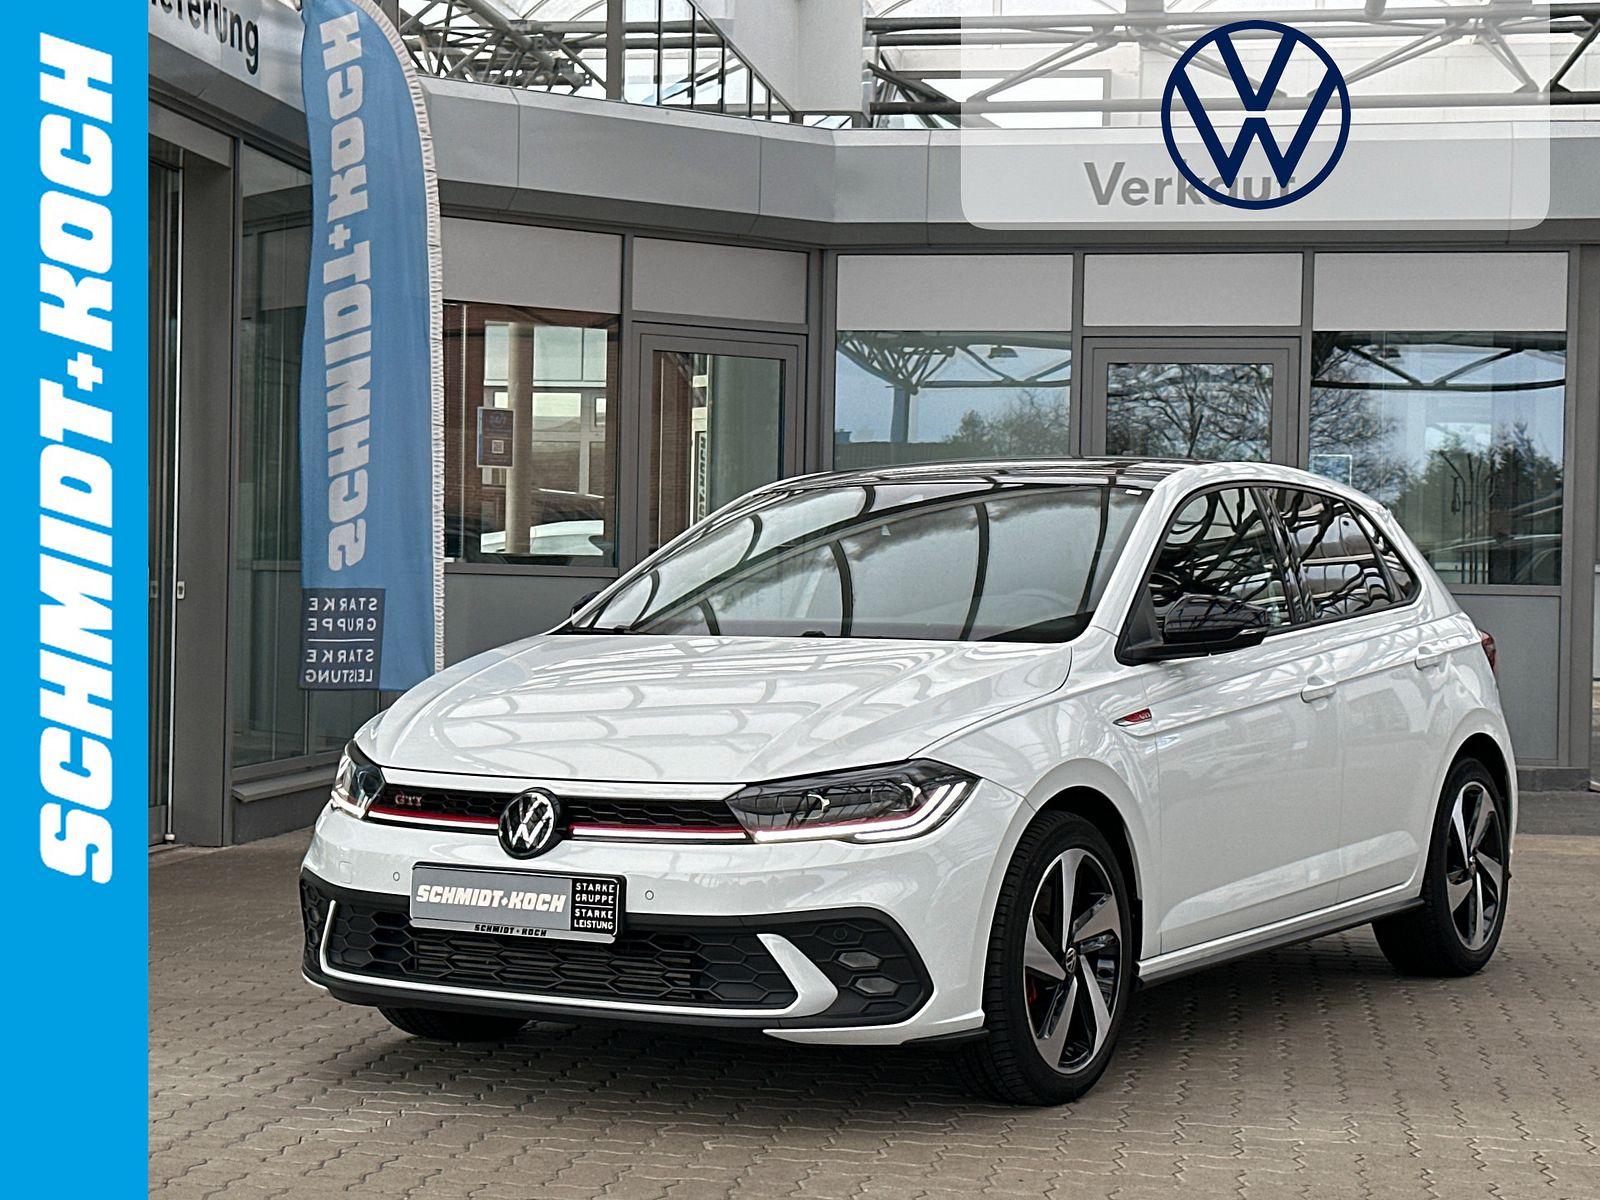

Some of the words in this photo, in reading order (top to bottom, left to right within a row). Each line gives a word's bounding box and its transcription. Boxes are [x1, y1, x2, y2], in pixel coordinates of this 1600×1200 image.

[394, 794, 422, 806] GTI
[575, 882, 615, 893] STARKE
[575, 893, 614, 904] GRUPPE
[574, 908, 613, 919] STARKE
[574, 919, 613, 930] LEISTUNG
